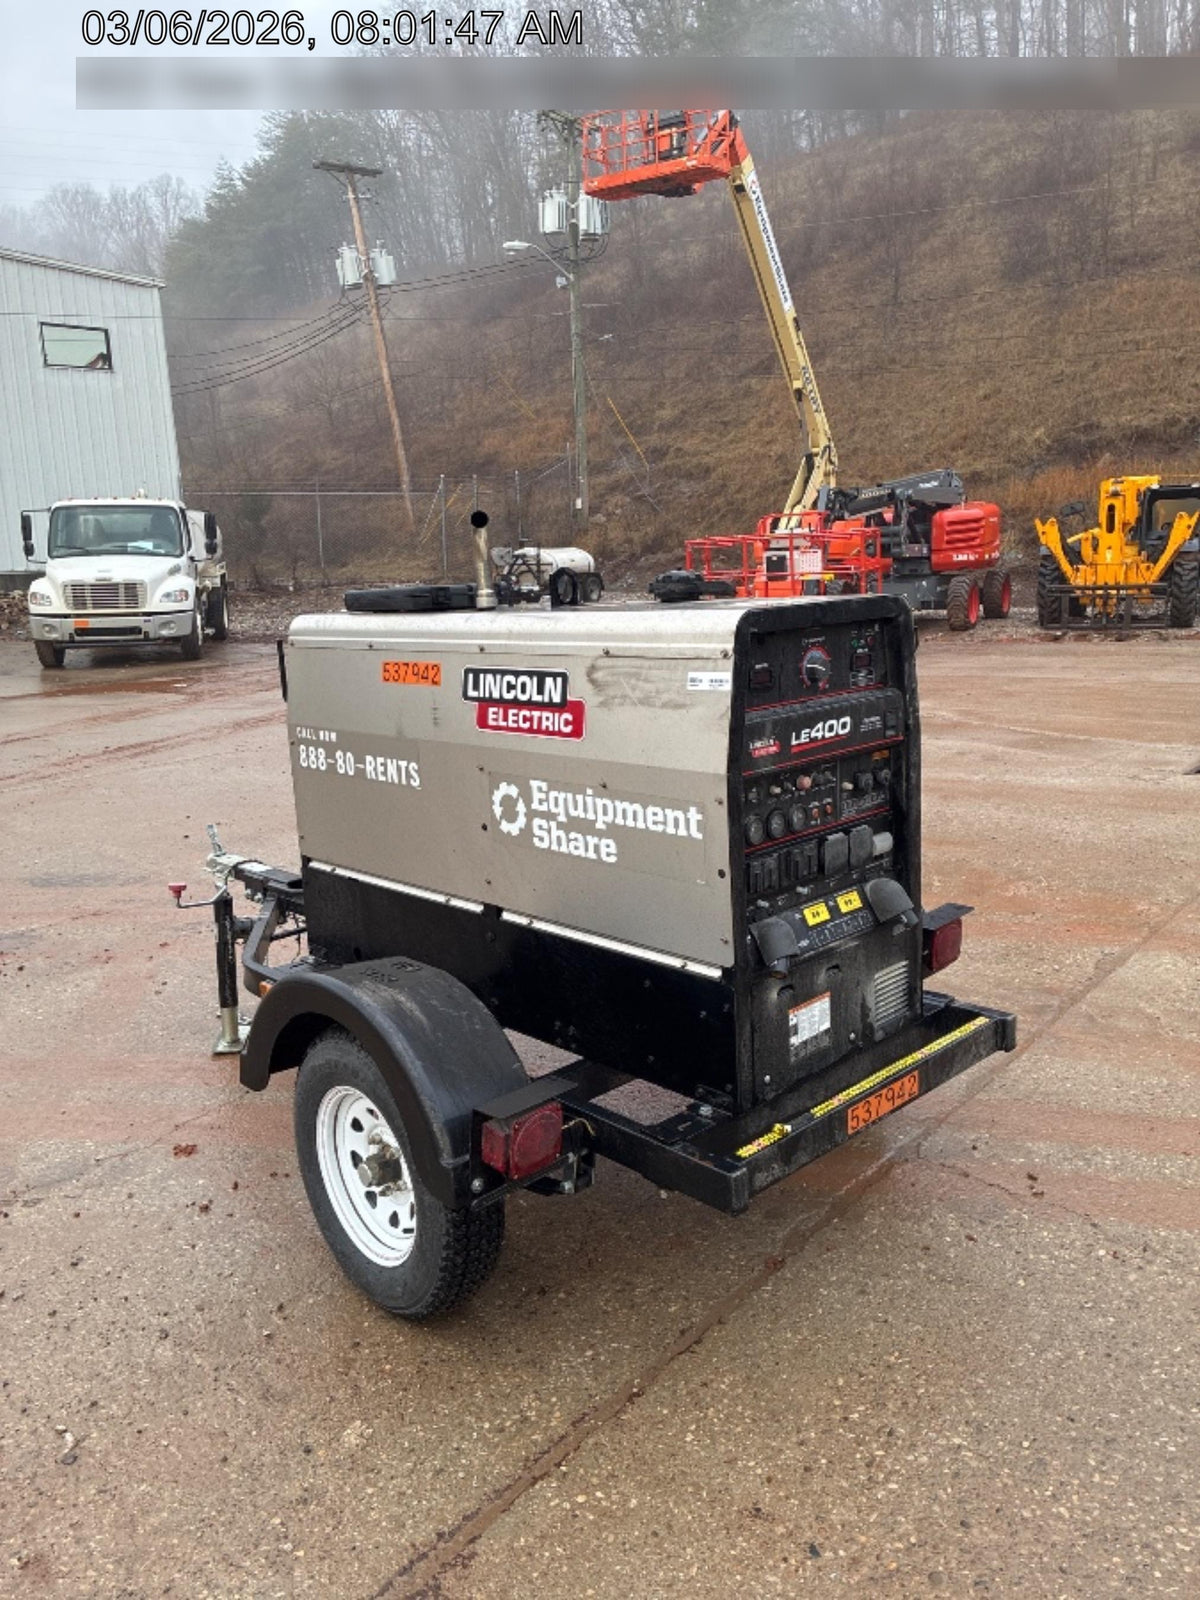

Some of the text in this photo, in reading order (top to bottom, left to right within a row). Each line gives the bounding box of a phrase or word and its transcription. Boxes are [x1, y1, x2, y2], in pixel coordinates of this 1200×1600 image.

[382, 661, 441, 686] 537942
[467, 673, 564, 704] LINCOLN
[487, 707, 574, 734] ELECTRIC
[791, 716, 851, 745] LE400
[299, 745, 421, 789] 888-80-RENTS
[529, 780, 704, 840] Equipment
[532, 821, 618, 863] Share
[850, 1075, 917, 1131] 537942
